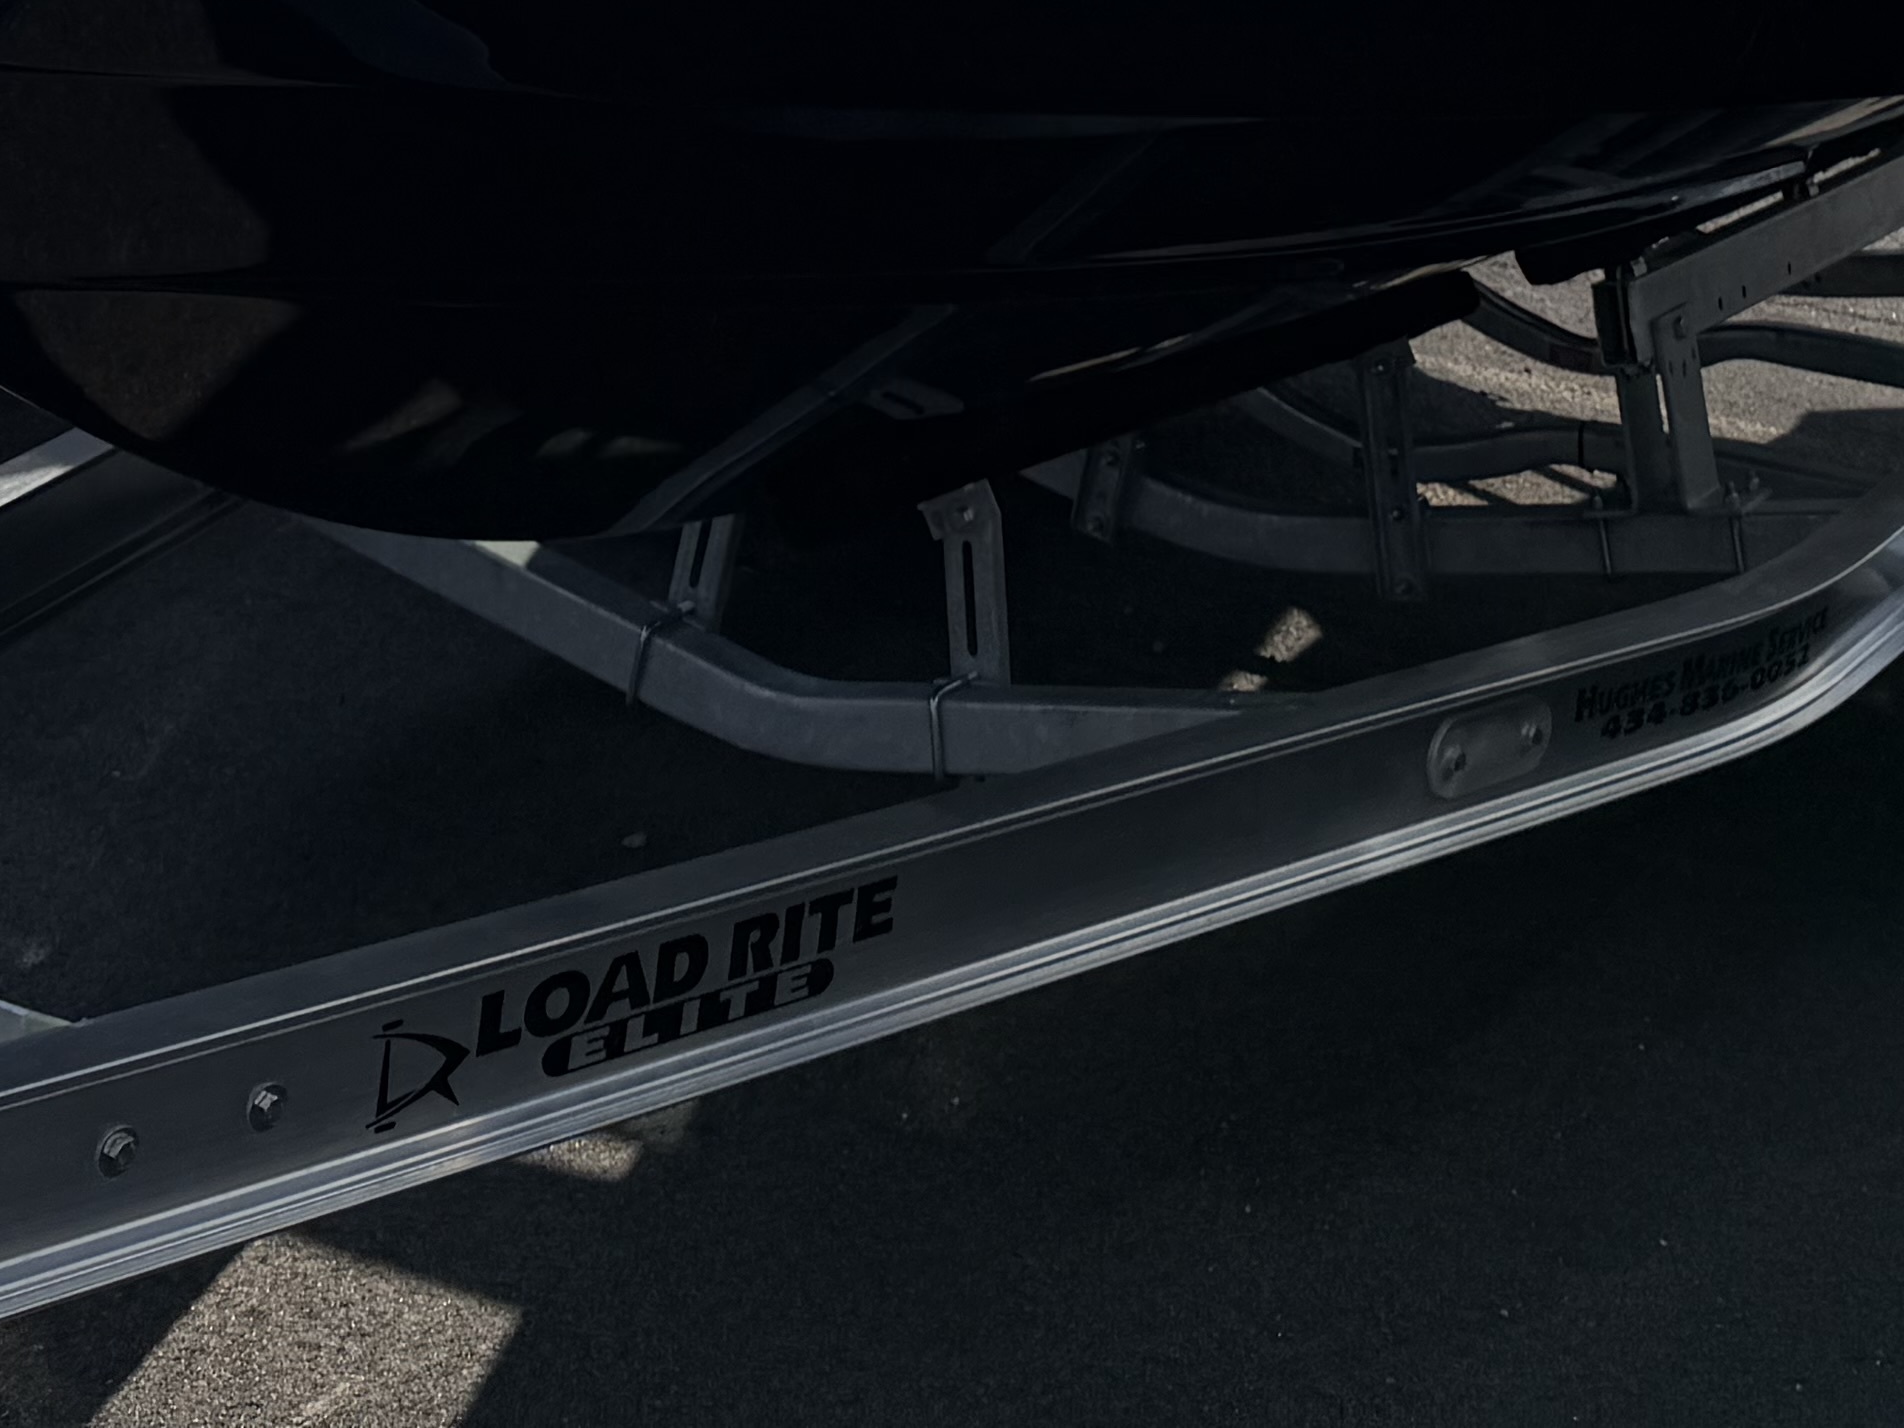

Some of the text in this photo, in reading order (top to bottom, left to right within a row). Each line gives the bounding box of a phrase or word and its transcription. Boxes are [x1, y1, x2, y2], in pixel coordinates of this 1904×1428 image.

[1574, 669, 1677, 723] HUGHES
[476, 876, 898, 1057] LOAD RITE
[566, 961, 814, 1072] ELITE
